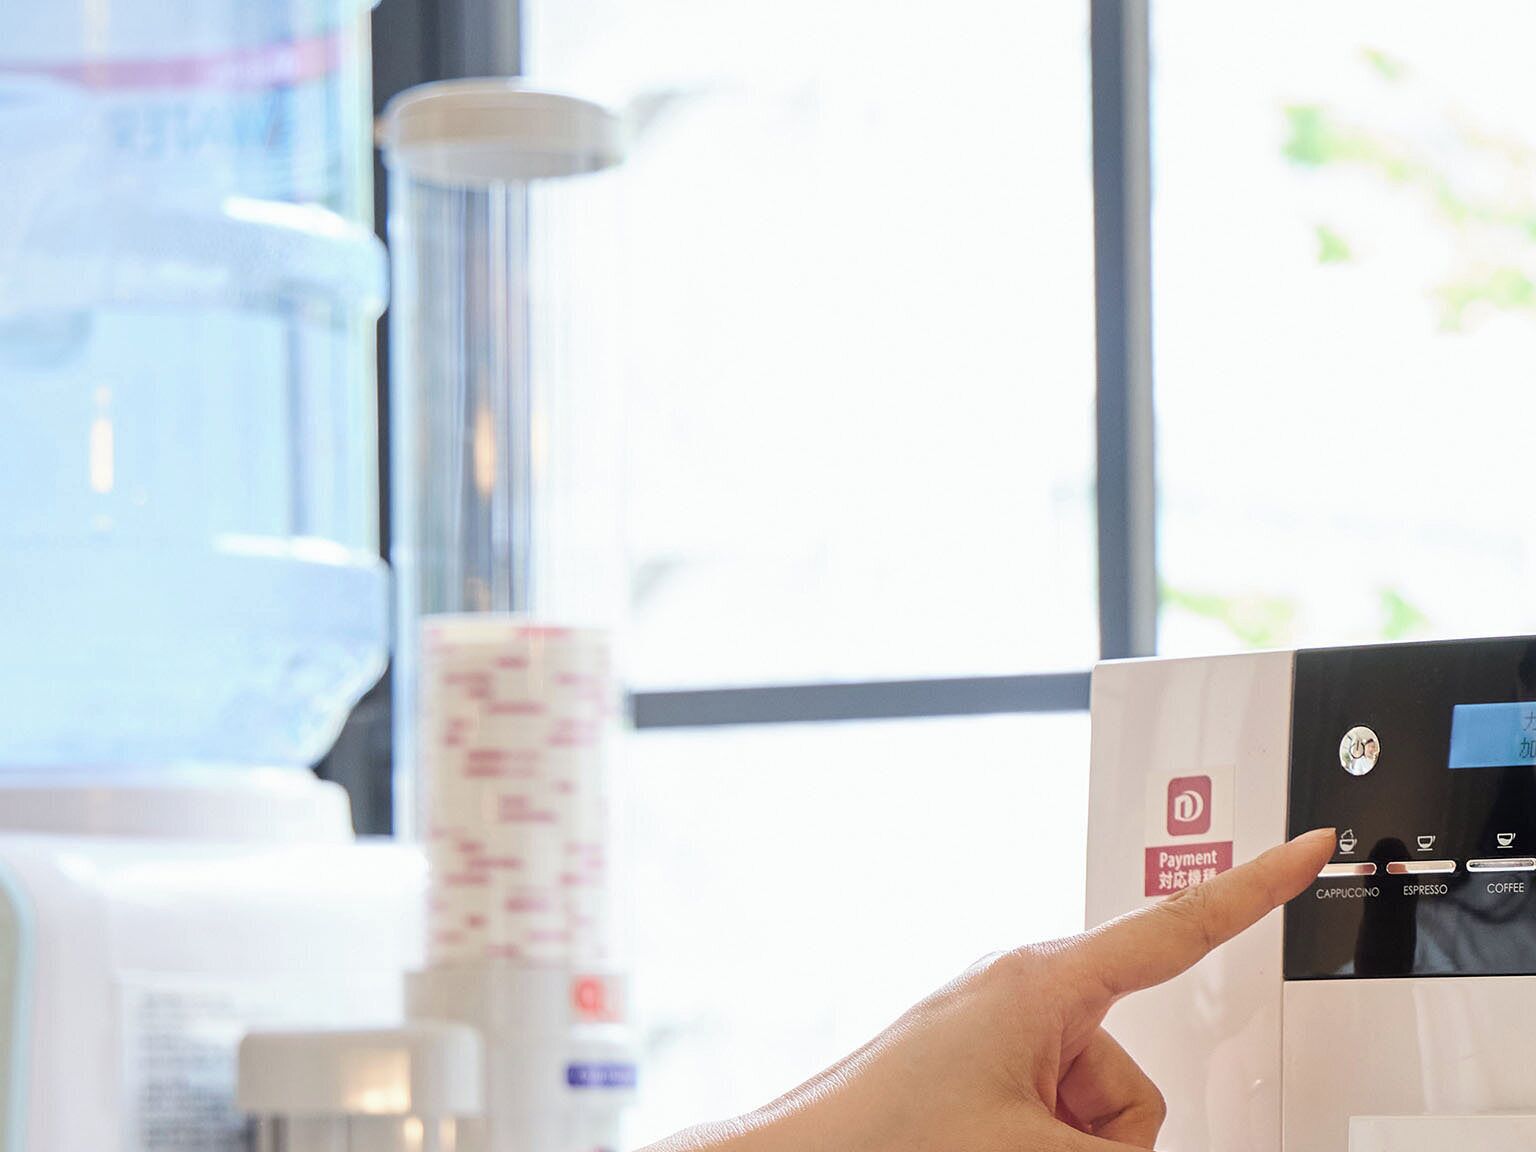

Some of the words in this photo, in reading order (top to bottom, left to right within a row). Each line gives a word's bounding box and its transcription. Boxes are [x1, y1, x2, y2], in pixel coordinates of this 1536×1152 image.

[1159, 849, 1218, 870] Payment
[1316, 886, 1380, 899] CAPPUCCINO
[1403, 884, 1448, 896] ESPRESSO
[1487, 882, 1525, 894] COFFEE
